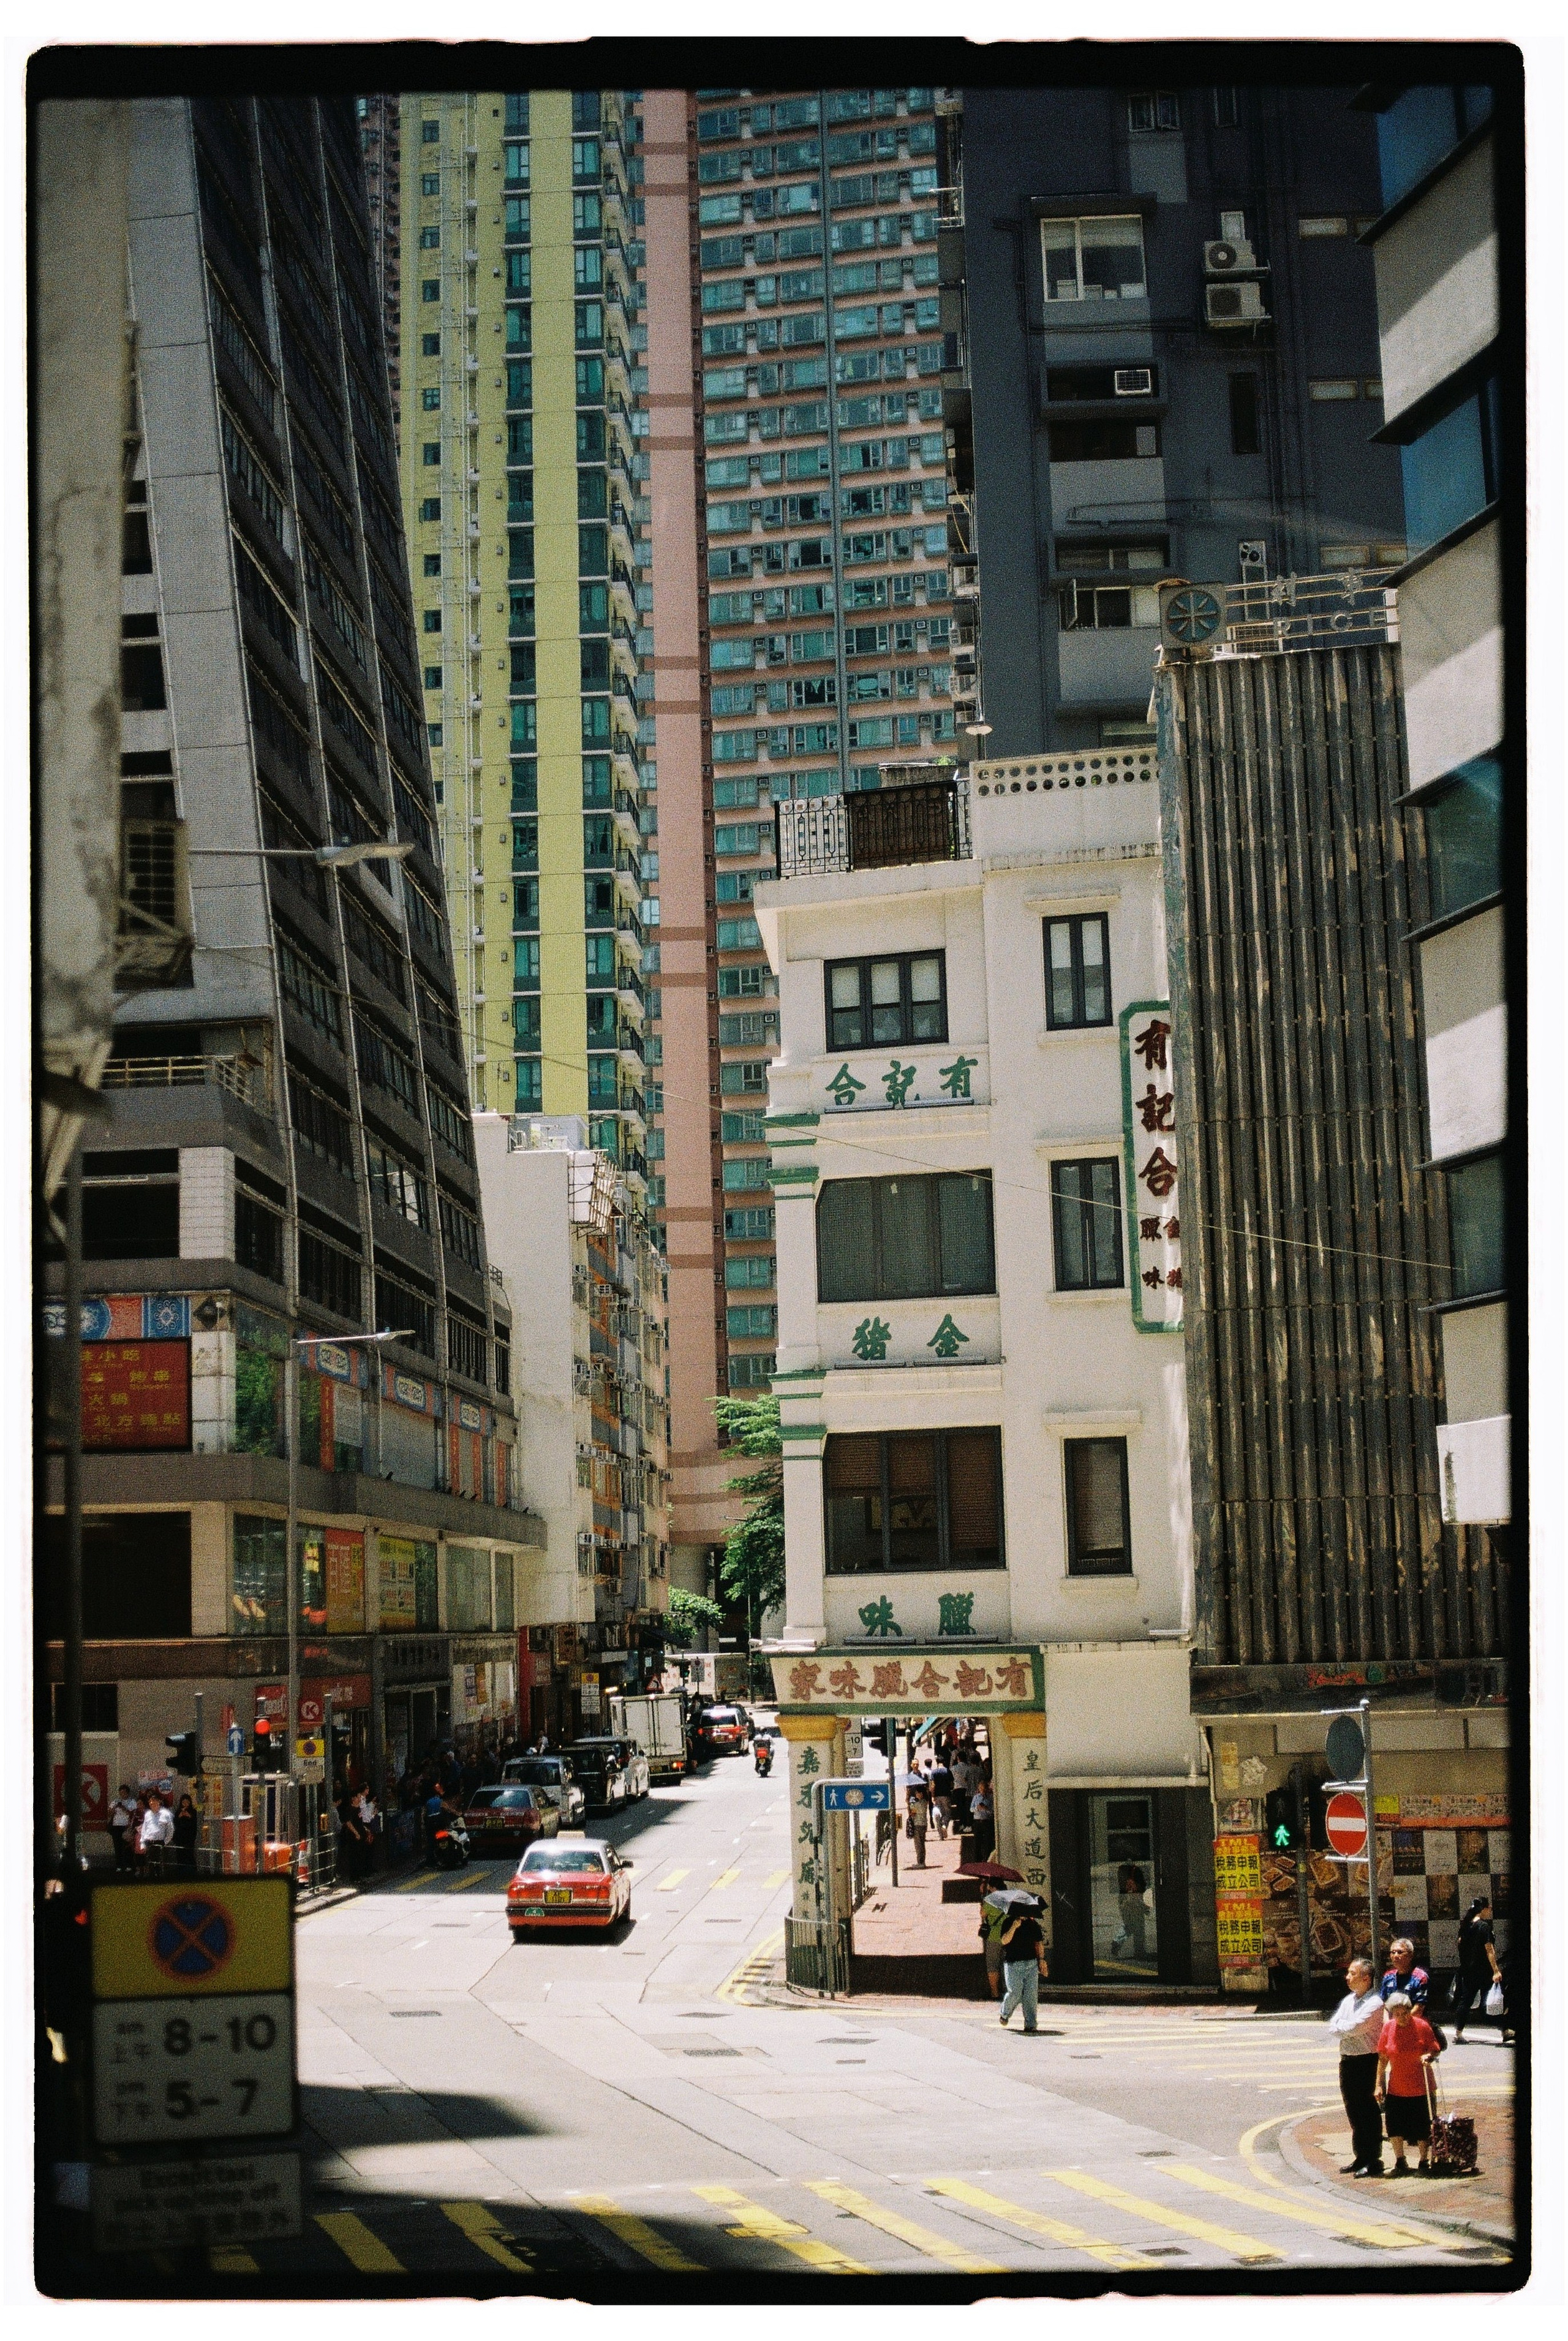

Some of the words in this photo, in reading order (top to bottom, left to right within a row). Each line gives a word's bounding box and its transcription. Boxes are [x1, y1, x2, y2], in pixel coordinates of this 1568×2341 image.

[1023, 1749, 1046, 1886] 皇后大道西
[1218, 1838, 1253, 1847] TML
[1223, 1902, 1256, 1911] TML
[163, 2014, 277, 2056] 8-10
